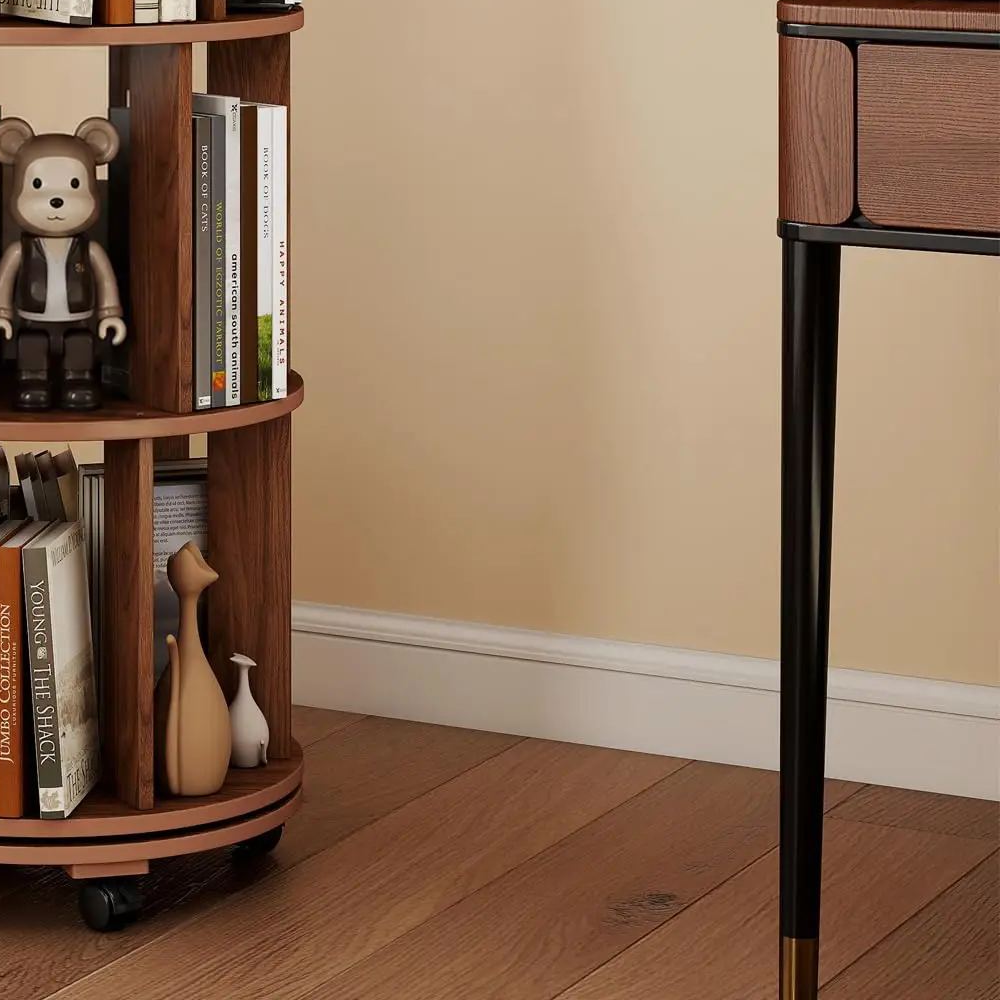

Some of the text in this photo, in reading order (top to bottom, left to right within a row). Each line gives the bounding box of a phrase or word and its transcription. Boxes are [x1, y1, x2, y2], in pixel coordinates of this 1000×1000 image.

[201, 183, 208, 199] OF
[263, 185, 269, 202] OF
[215, 200, 223, 364] WORLD OF EGZOTIC PARROT
[231, 254, 239, 399] american south animals
[29, 579, 57, 765] YOUNG THE SHACK
